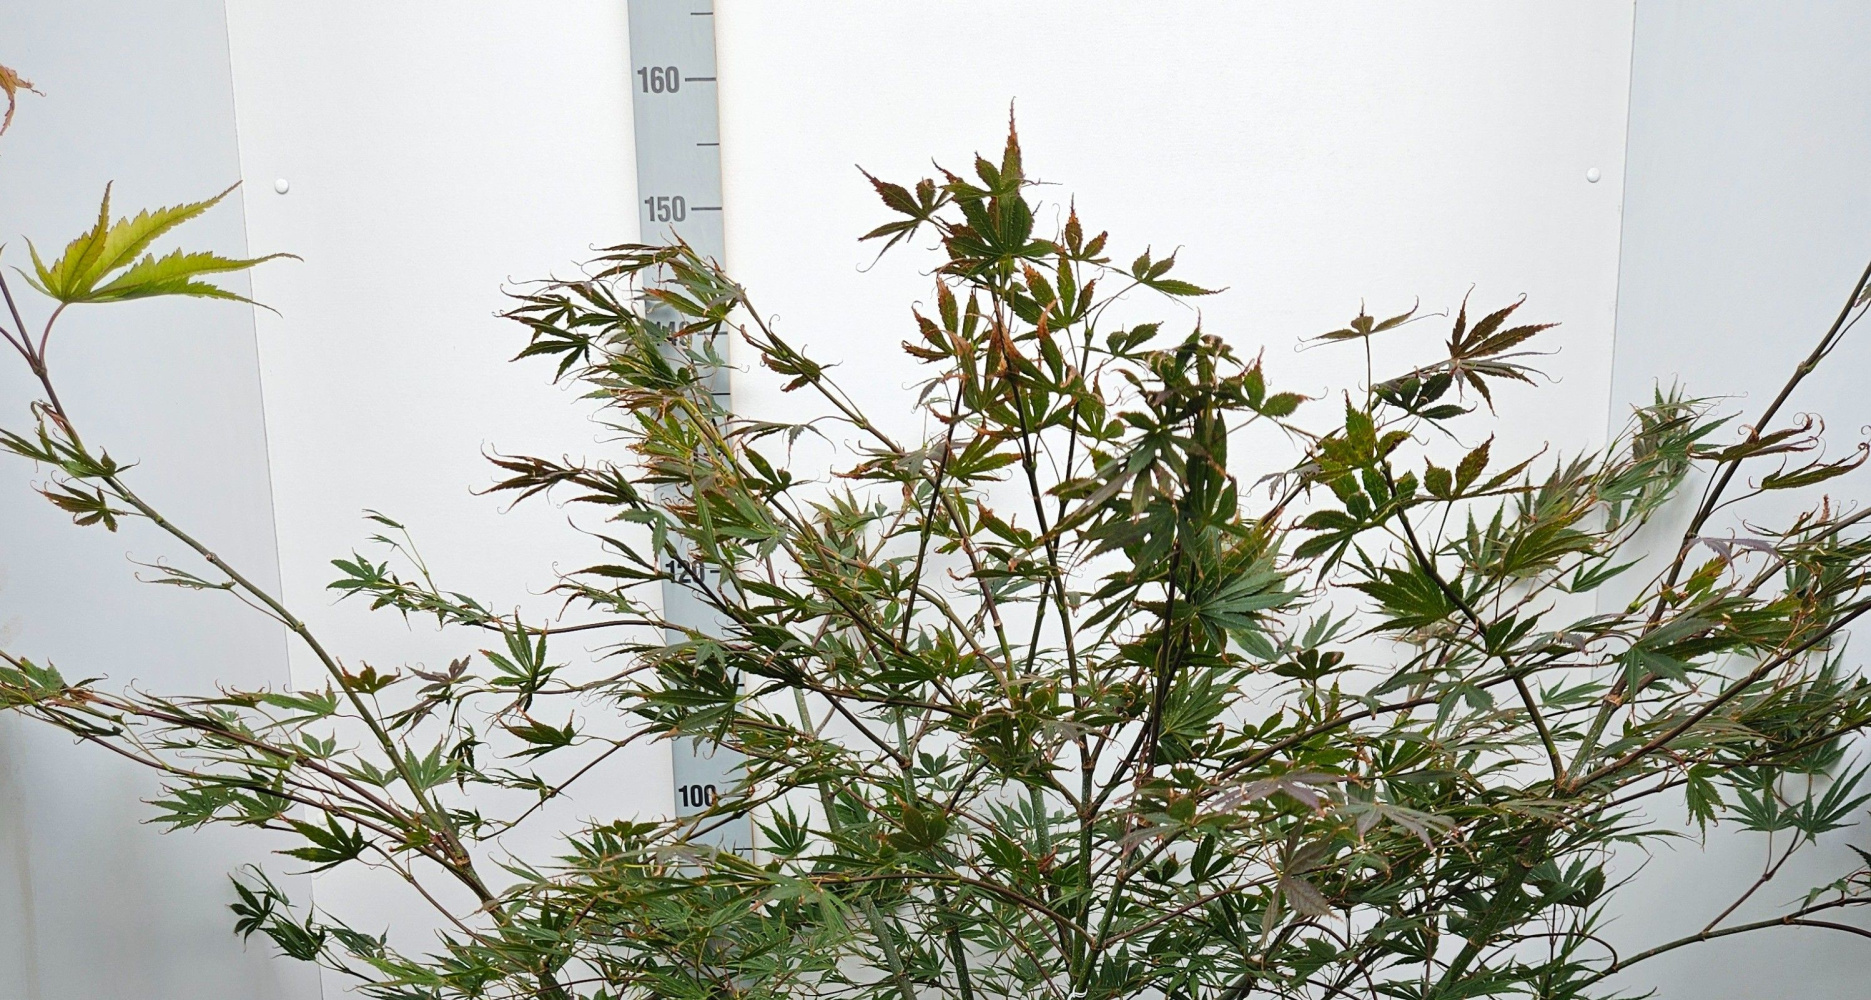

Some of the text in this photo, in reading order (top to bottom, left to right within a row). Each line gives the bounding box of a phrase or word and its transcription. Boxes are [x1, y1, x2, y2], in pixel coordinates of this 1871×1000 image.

[637, 66, 680, 93] 160
[644, 196, 686, 222] 150
[665, 559, 706, 583] 120
[678, 784, 716, 808] 100
